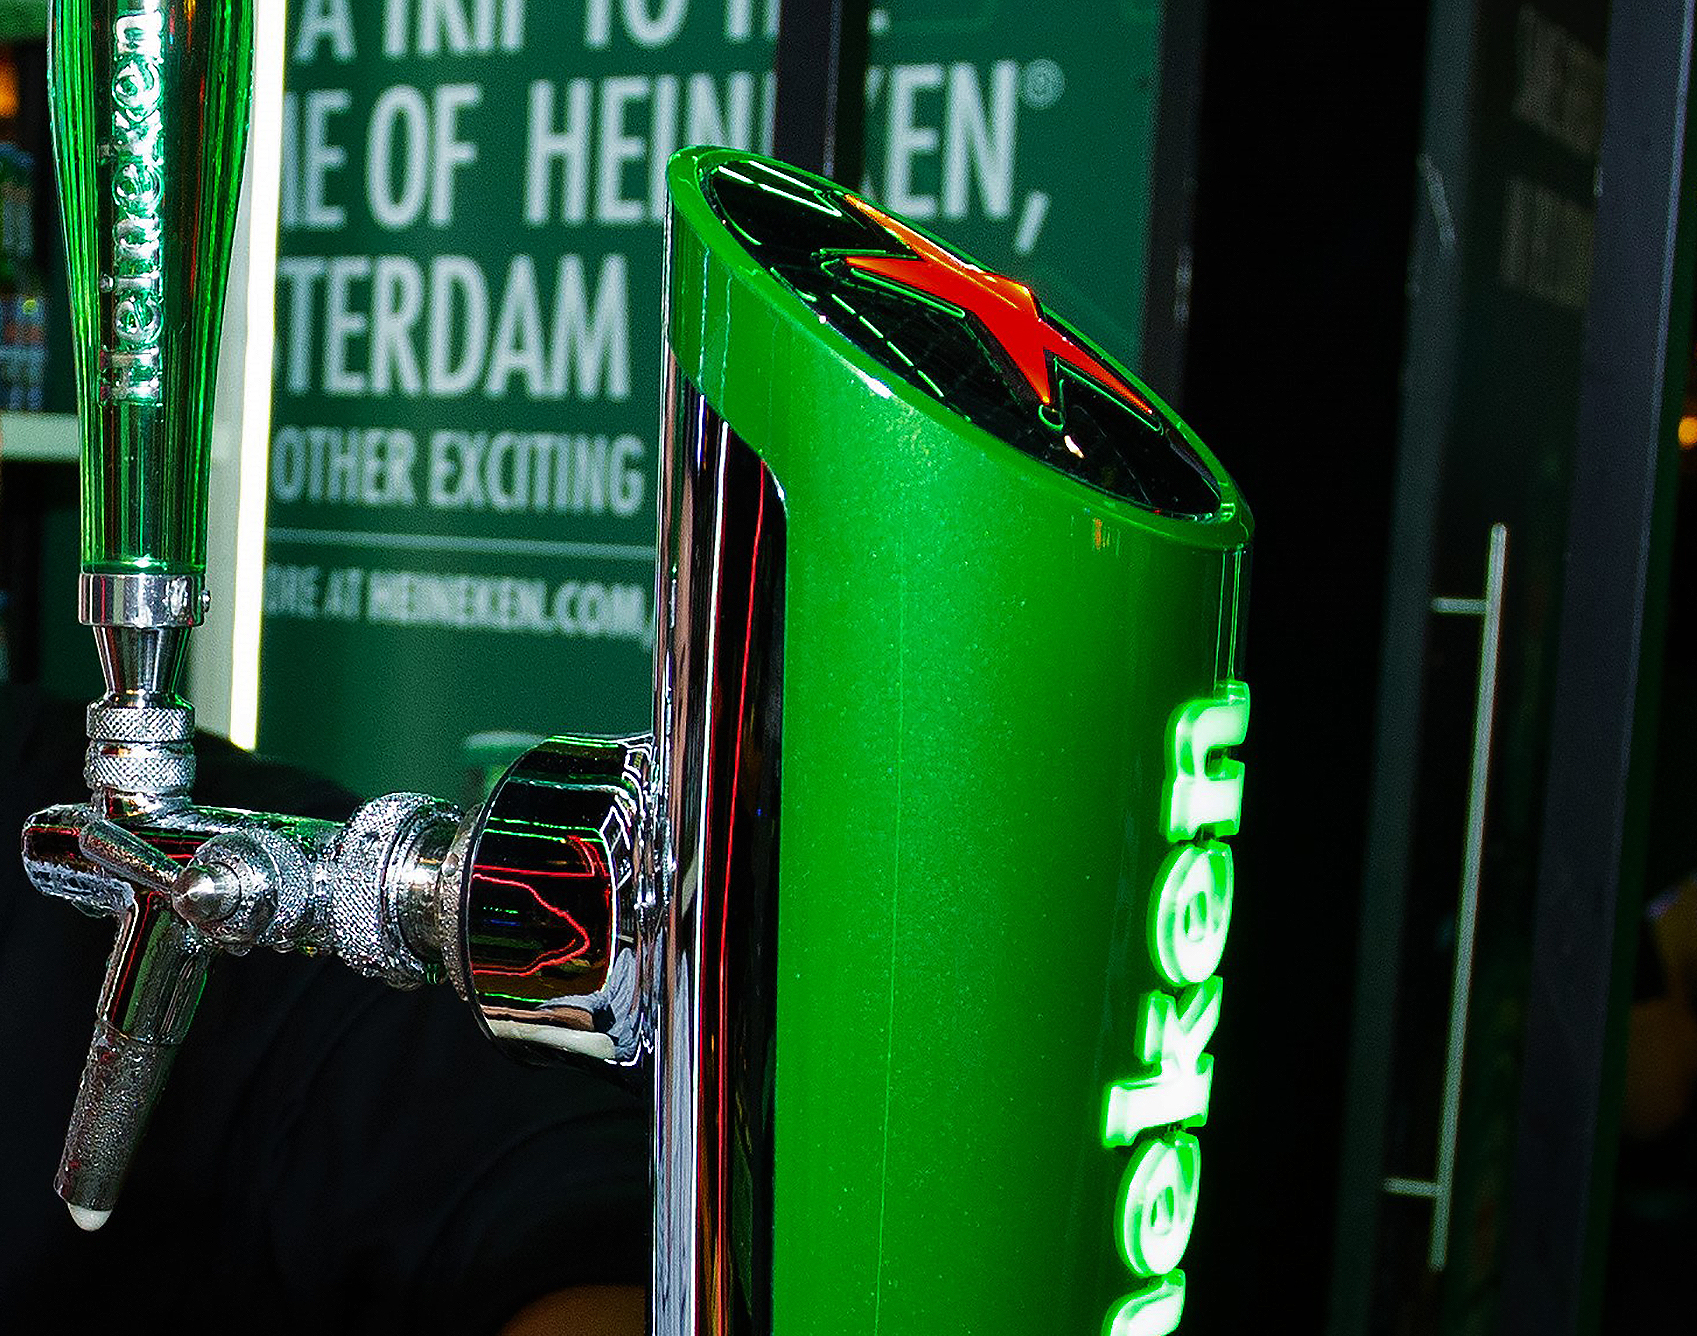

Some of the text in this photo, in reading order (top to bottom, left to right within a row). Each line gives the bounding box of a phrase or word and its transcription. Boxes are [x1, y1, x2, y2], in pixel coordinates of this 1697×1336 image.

[365, 84, 482, 228] OF
[277, 254, 632, 400] TERDAM
[271, 425, 646, 518] OTHER EXCITING
[324, 567, 365, 621] AT
